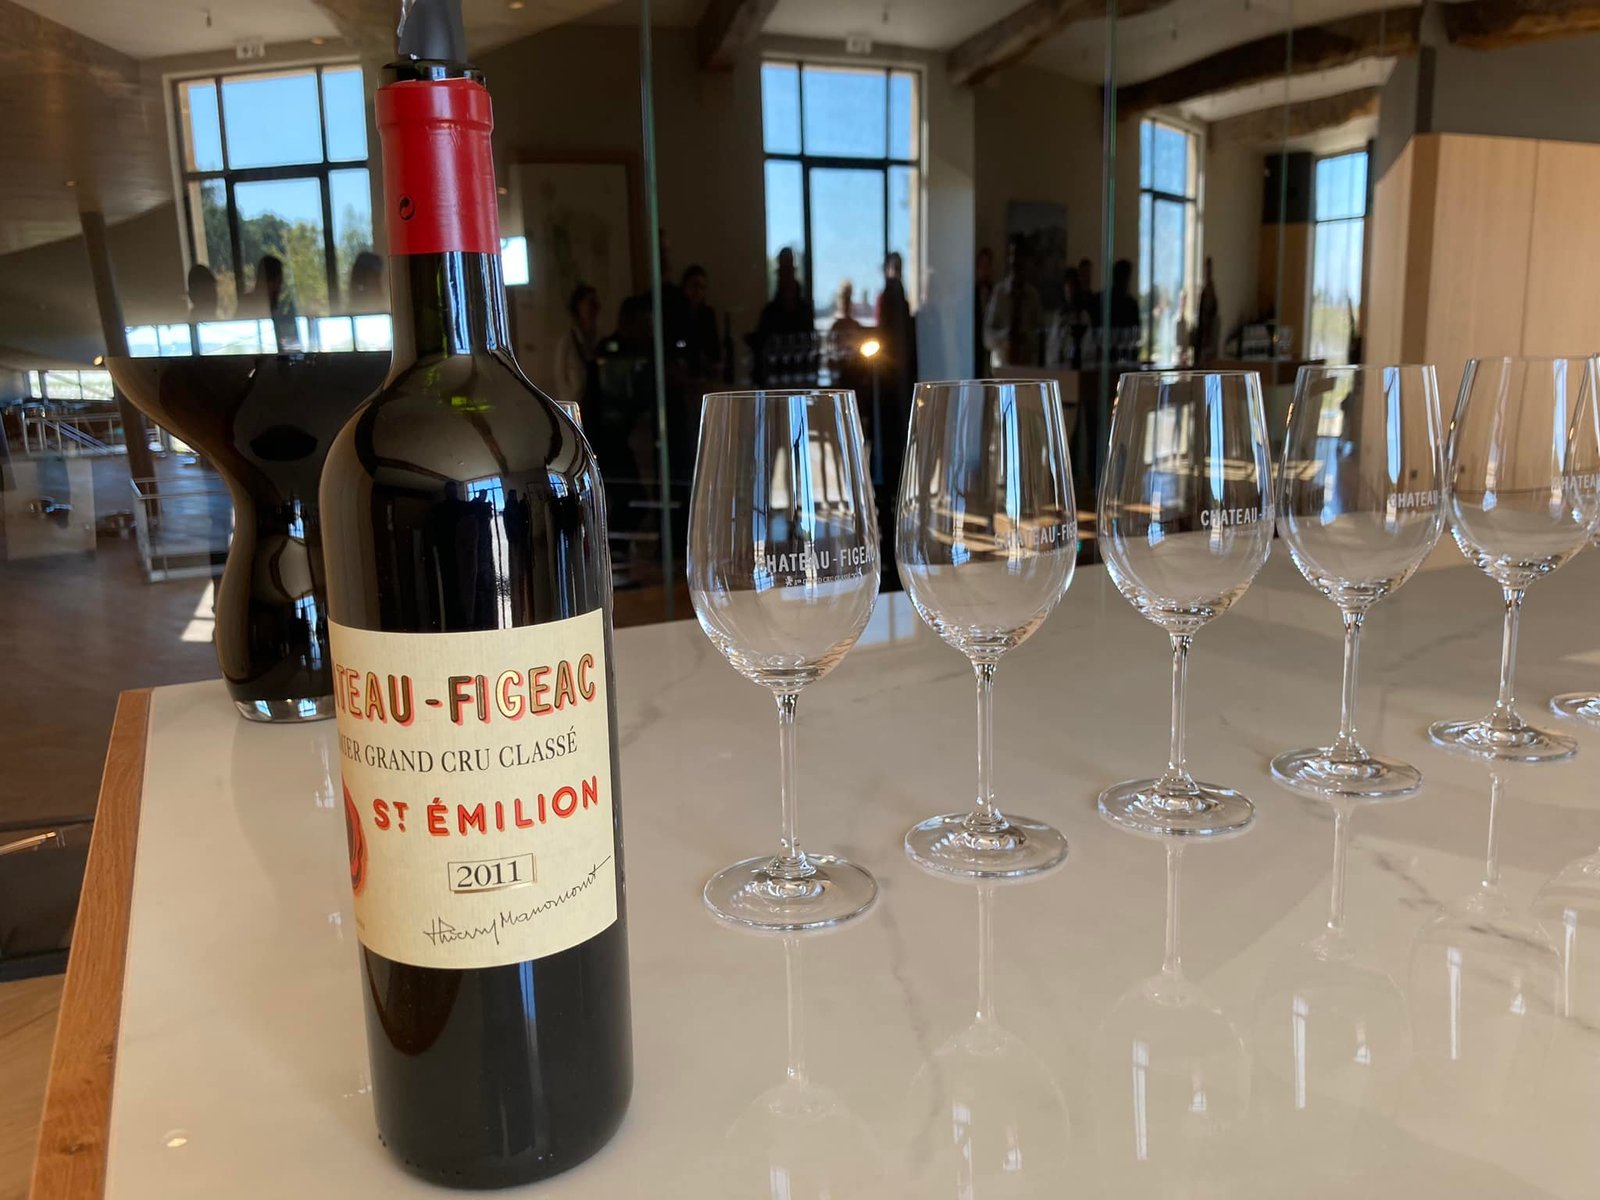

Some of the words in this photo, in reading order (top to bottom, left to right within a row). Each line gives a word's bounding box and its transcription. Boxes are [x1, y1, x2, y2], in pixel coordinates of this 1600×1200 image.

[365, 744, 433, 773] GRAND
[441, 748, 490, 773] CRU
[499, 725, 578, 768] CLASSÉ
[427, 776, 598, 836] ÉMILION
[456, 860, 523, 888] 2011
